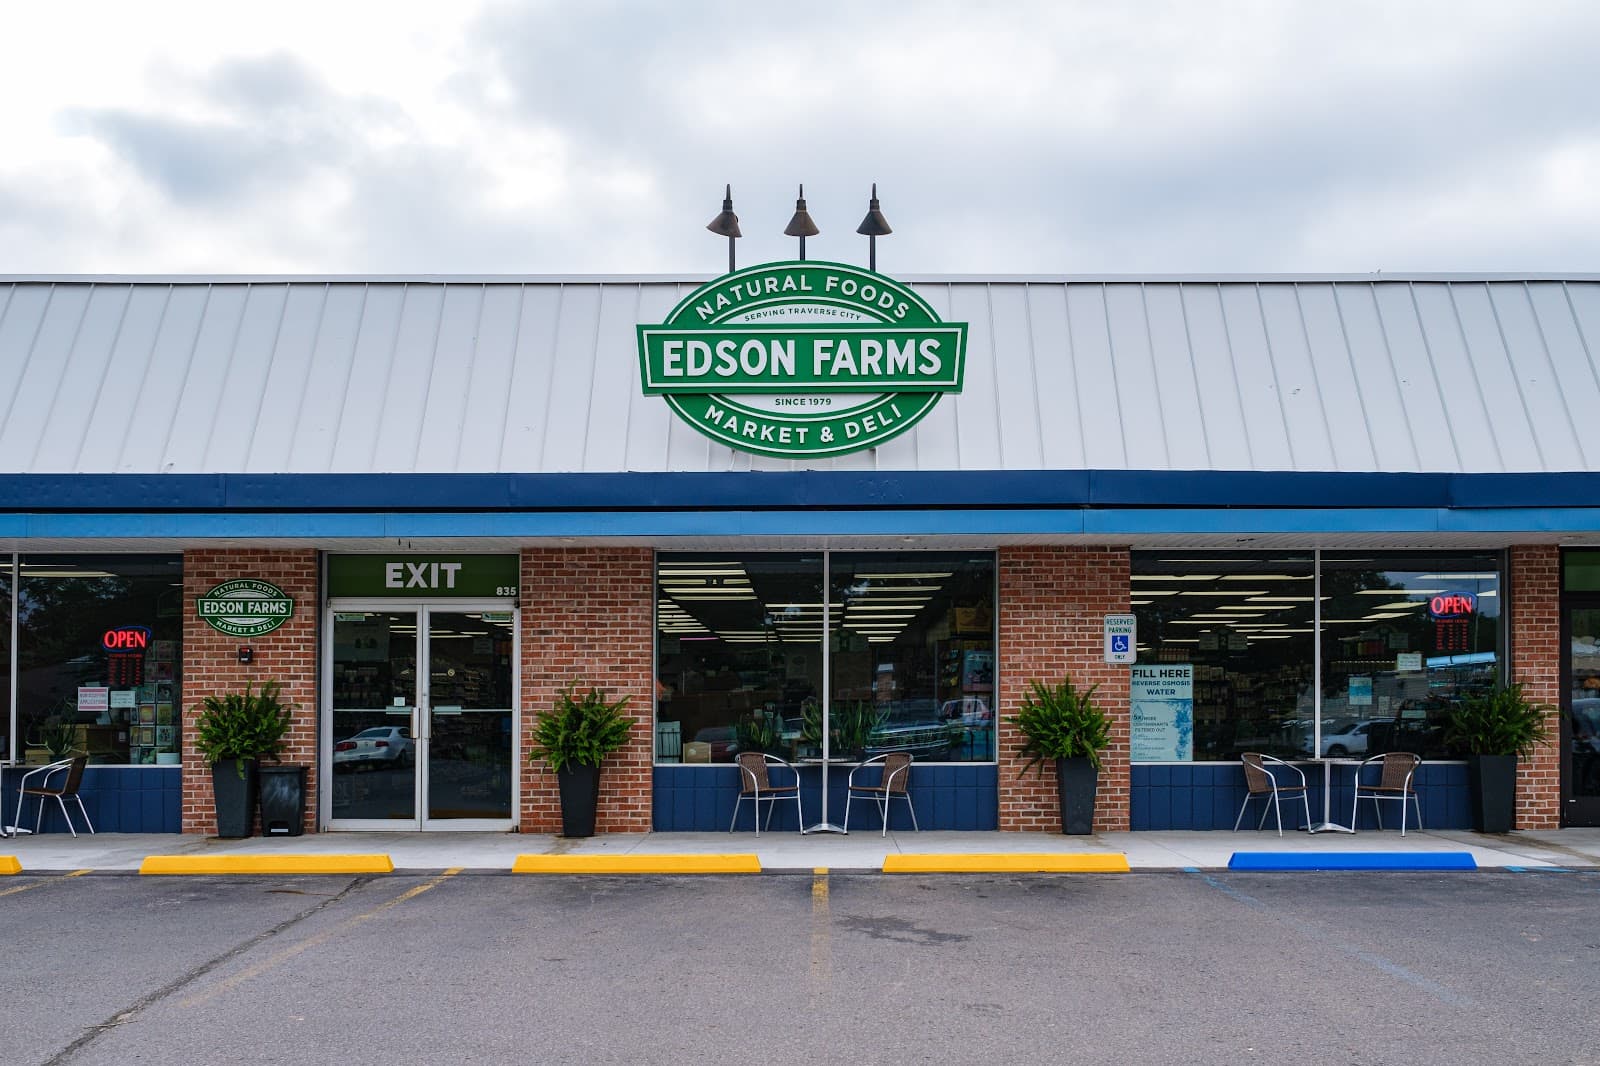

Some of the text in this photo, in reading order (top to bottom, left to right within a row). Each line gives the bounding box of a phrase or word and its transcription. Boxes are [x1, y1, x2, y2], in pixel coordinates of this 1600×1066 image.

[695, 274, 910, 321] NATURAL FOODS
[744, 307, 862, 322] SERVING TRAVERSE CITY
[663, 338, 942, 377] EDSON FARMS
[775, 398, 832, 406] SINCE 1979
[704, 403, 902, 444] MARKET & DELI
[385, 562, 462, 589] EXIT
[214, 582, 249, 597] NATURAL
[252, 583, 278, 597] FOODS
[496, 586, 517, 596] 835
[203, 601, 287, 614] EDSON FARMS
[1430, 596, 1472, 614] OPEN
[216, 620, 247, 633] MARKET
[257, 620, 276, 632] DELI
[103, 630, 147, 648] OPEN
[1132, 669, 1191, 678] FILL HERE
[1146, 688, 1176, 696] WATER
